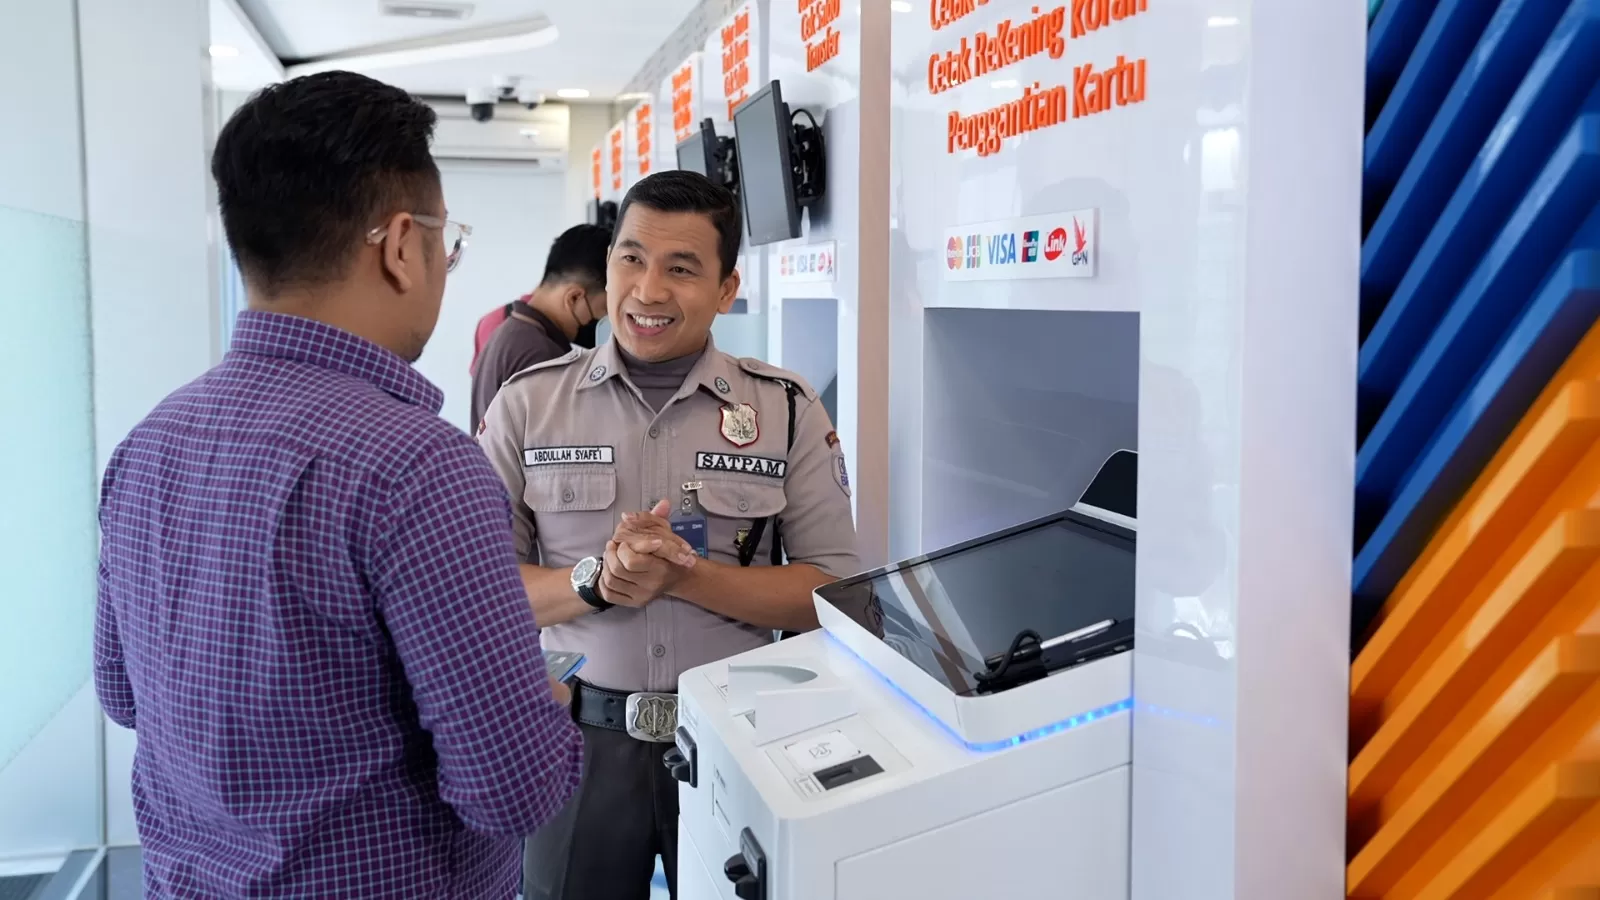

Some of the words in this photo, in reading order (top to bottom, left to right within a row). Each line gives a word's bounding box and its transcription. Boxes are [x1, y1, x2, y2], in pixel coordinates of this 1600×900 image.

[806, 26, 840, 72] Transfer
[928, 37, 971, 94] Cetak
[947, 81, 1066, 157] Penggantian
[1072, 55, 1147, 118] Kartu
[986, 233, 1016, 265] VISA
[1045, 233, 1065, 252] Link
[534, 449, 572, 462] ABDULLAH
[702, 453, 781, 476] SATPAM
